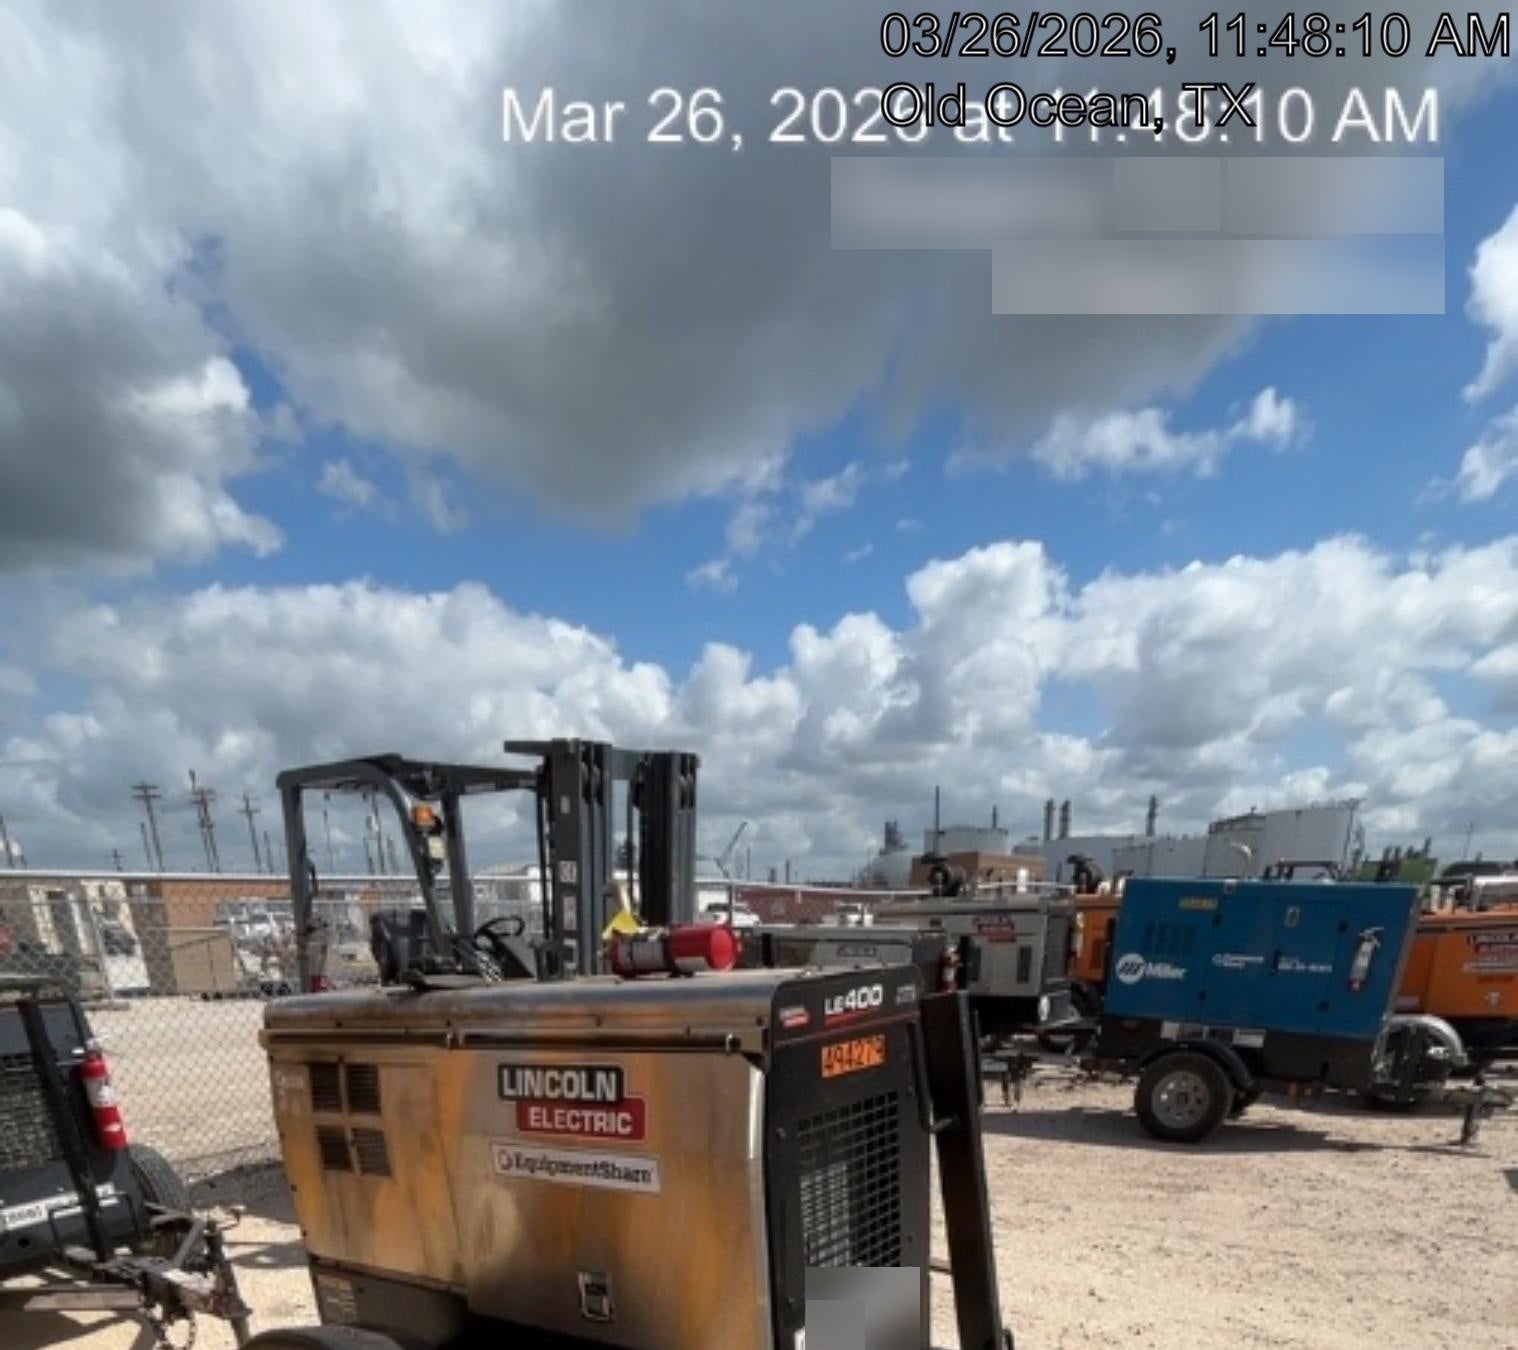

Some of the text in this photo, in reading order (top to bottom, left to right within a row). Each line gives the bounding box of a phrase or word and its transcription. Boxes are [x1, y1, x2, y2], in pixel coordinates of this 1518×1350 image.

[1144, 961, 1187, 979] Miller
[824, 983, 884, 1016] LE400
[502, 1067, 617, 1102] LINCOLN
[528, 1106, 633, 1136] ELECTRIC
